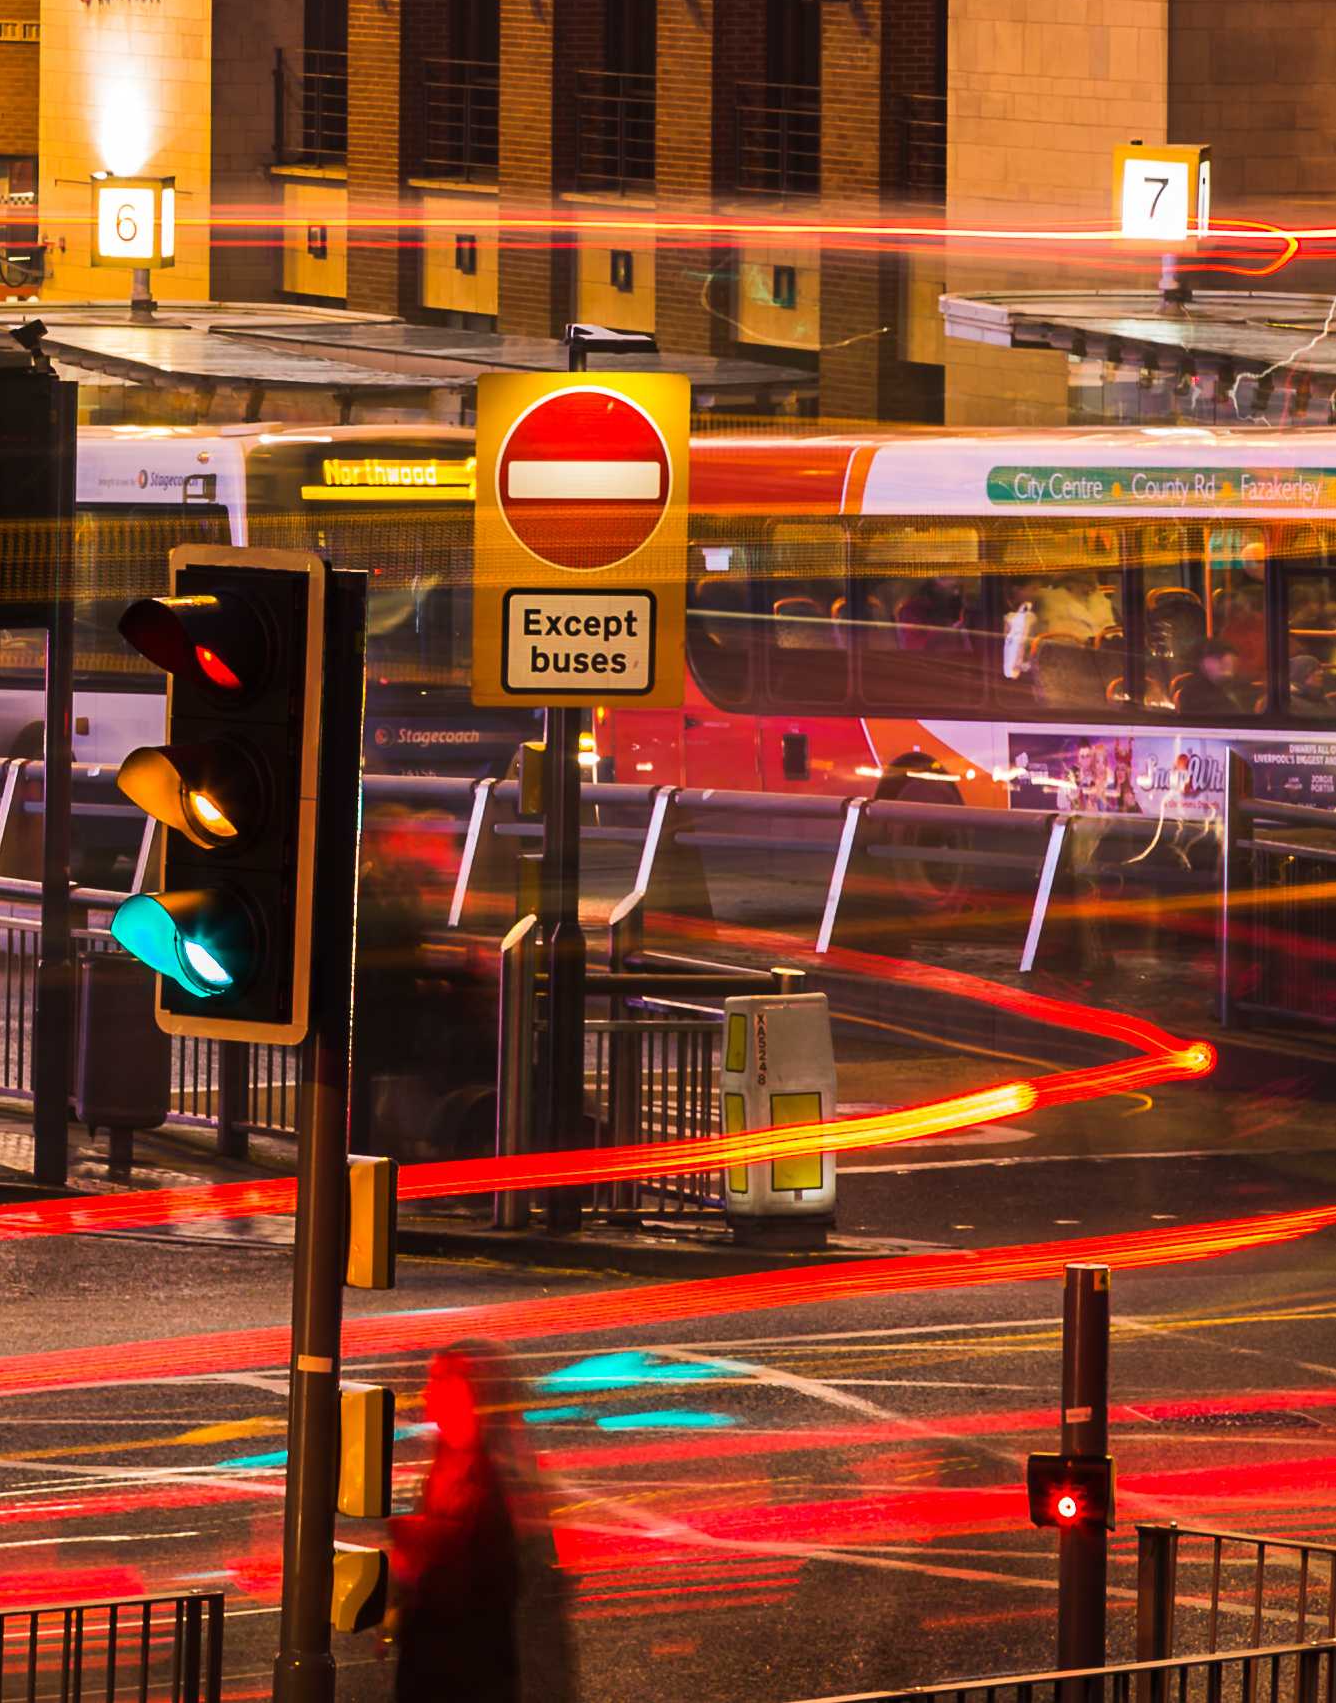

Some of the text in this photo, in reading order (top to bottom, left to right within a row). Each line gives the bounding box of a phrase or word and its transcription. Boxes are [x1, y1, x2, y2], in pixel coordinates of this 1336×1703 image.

[1144, 177, 1169, 219] 7
[116, 203, 137, 242] 6
[323, 458, 437, 485] Northwood
[1014, 472, 1321, 507] City Centre County Rd Fazakerley
[523, 608, 637, 641] Except
[531, 645, 626, 674] buses
[397, 728, 479, 747] Stagecoach
[757, 1013, 767, 1086] XA5248
